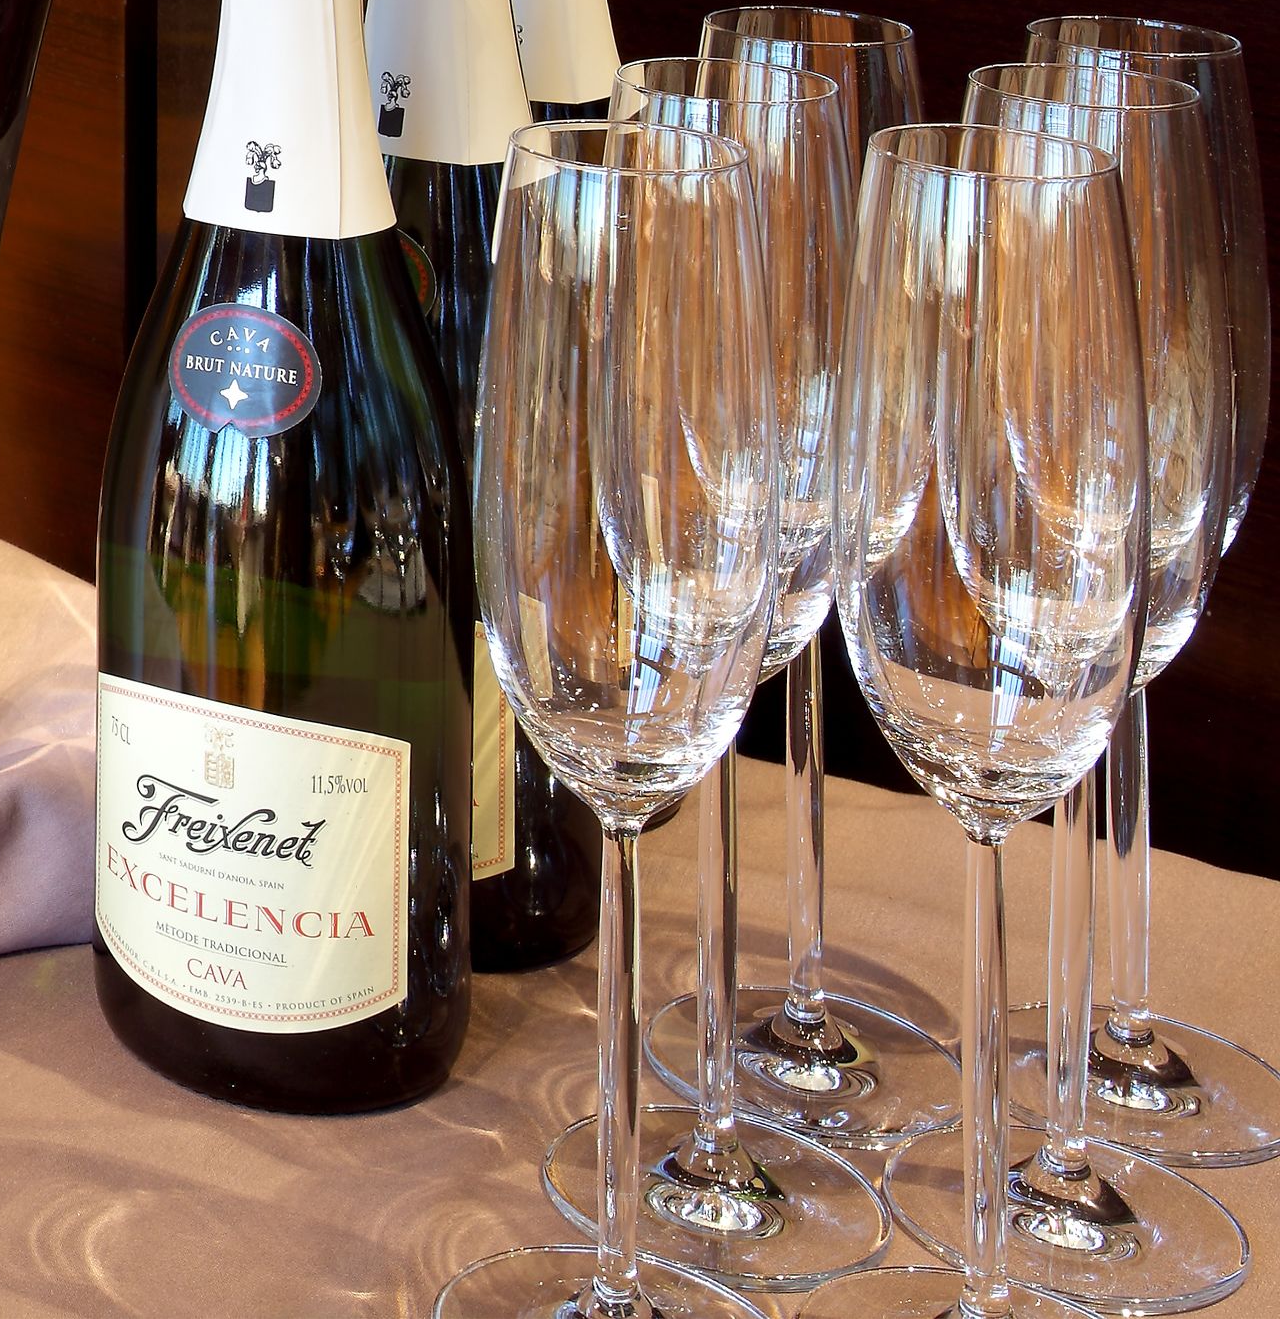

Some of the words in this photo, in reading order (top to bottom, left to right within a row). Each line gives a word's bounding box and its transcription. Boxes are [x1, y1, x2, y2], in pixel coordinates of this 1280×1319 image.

[210, 326, 270, 353] CAVA
[186, 355, 225, 373] BRUT
[229, 361, 298, 385] NATURE
[121, 774, 327, 867] Freixenet
[159, 852, 178, 865] SANT
[258, 880, 285, 890] SPAIN
[106, 842, 375, 939] EXCELENCIA
[202, 937, 287, 964] TRADICIONAL
[186, 958, 249, 990] CAVA
[275, 999, 326, 1011] PRODUCT
[330, 996, 343, 1006] OF
[347, 985, 375, 1001] SPAIN
